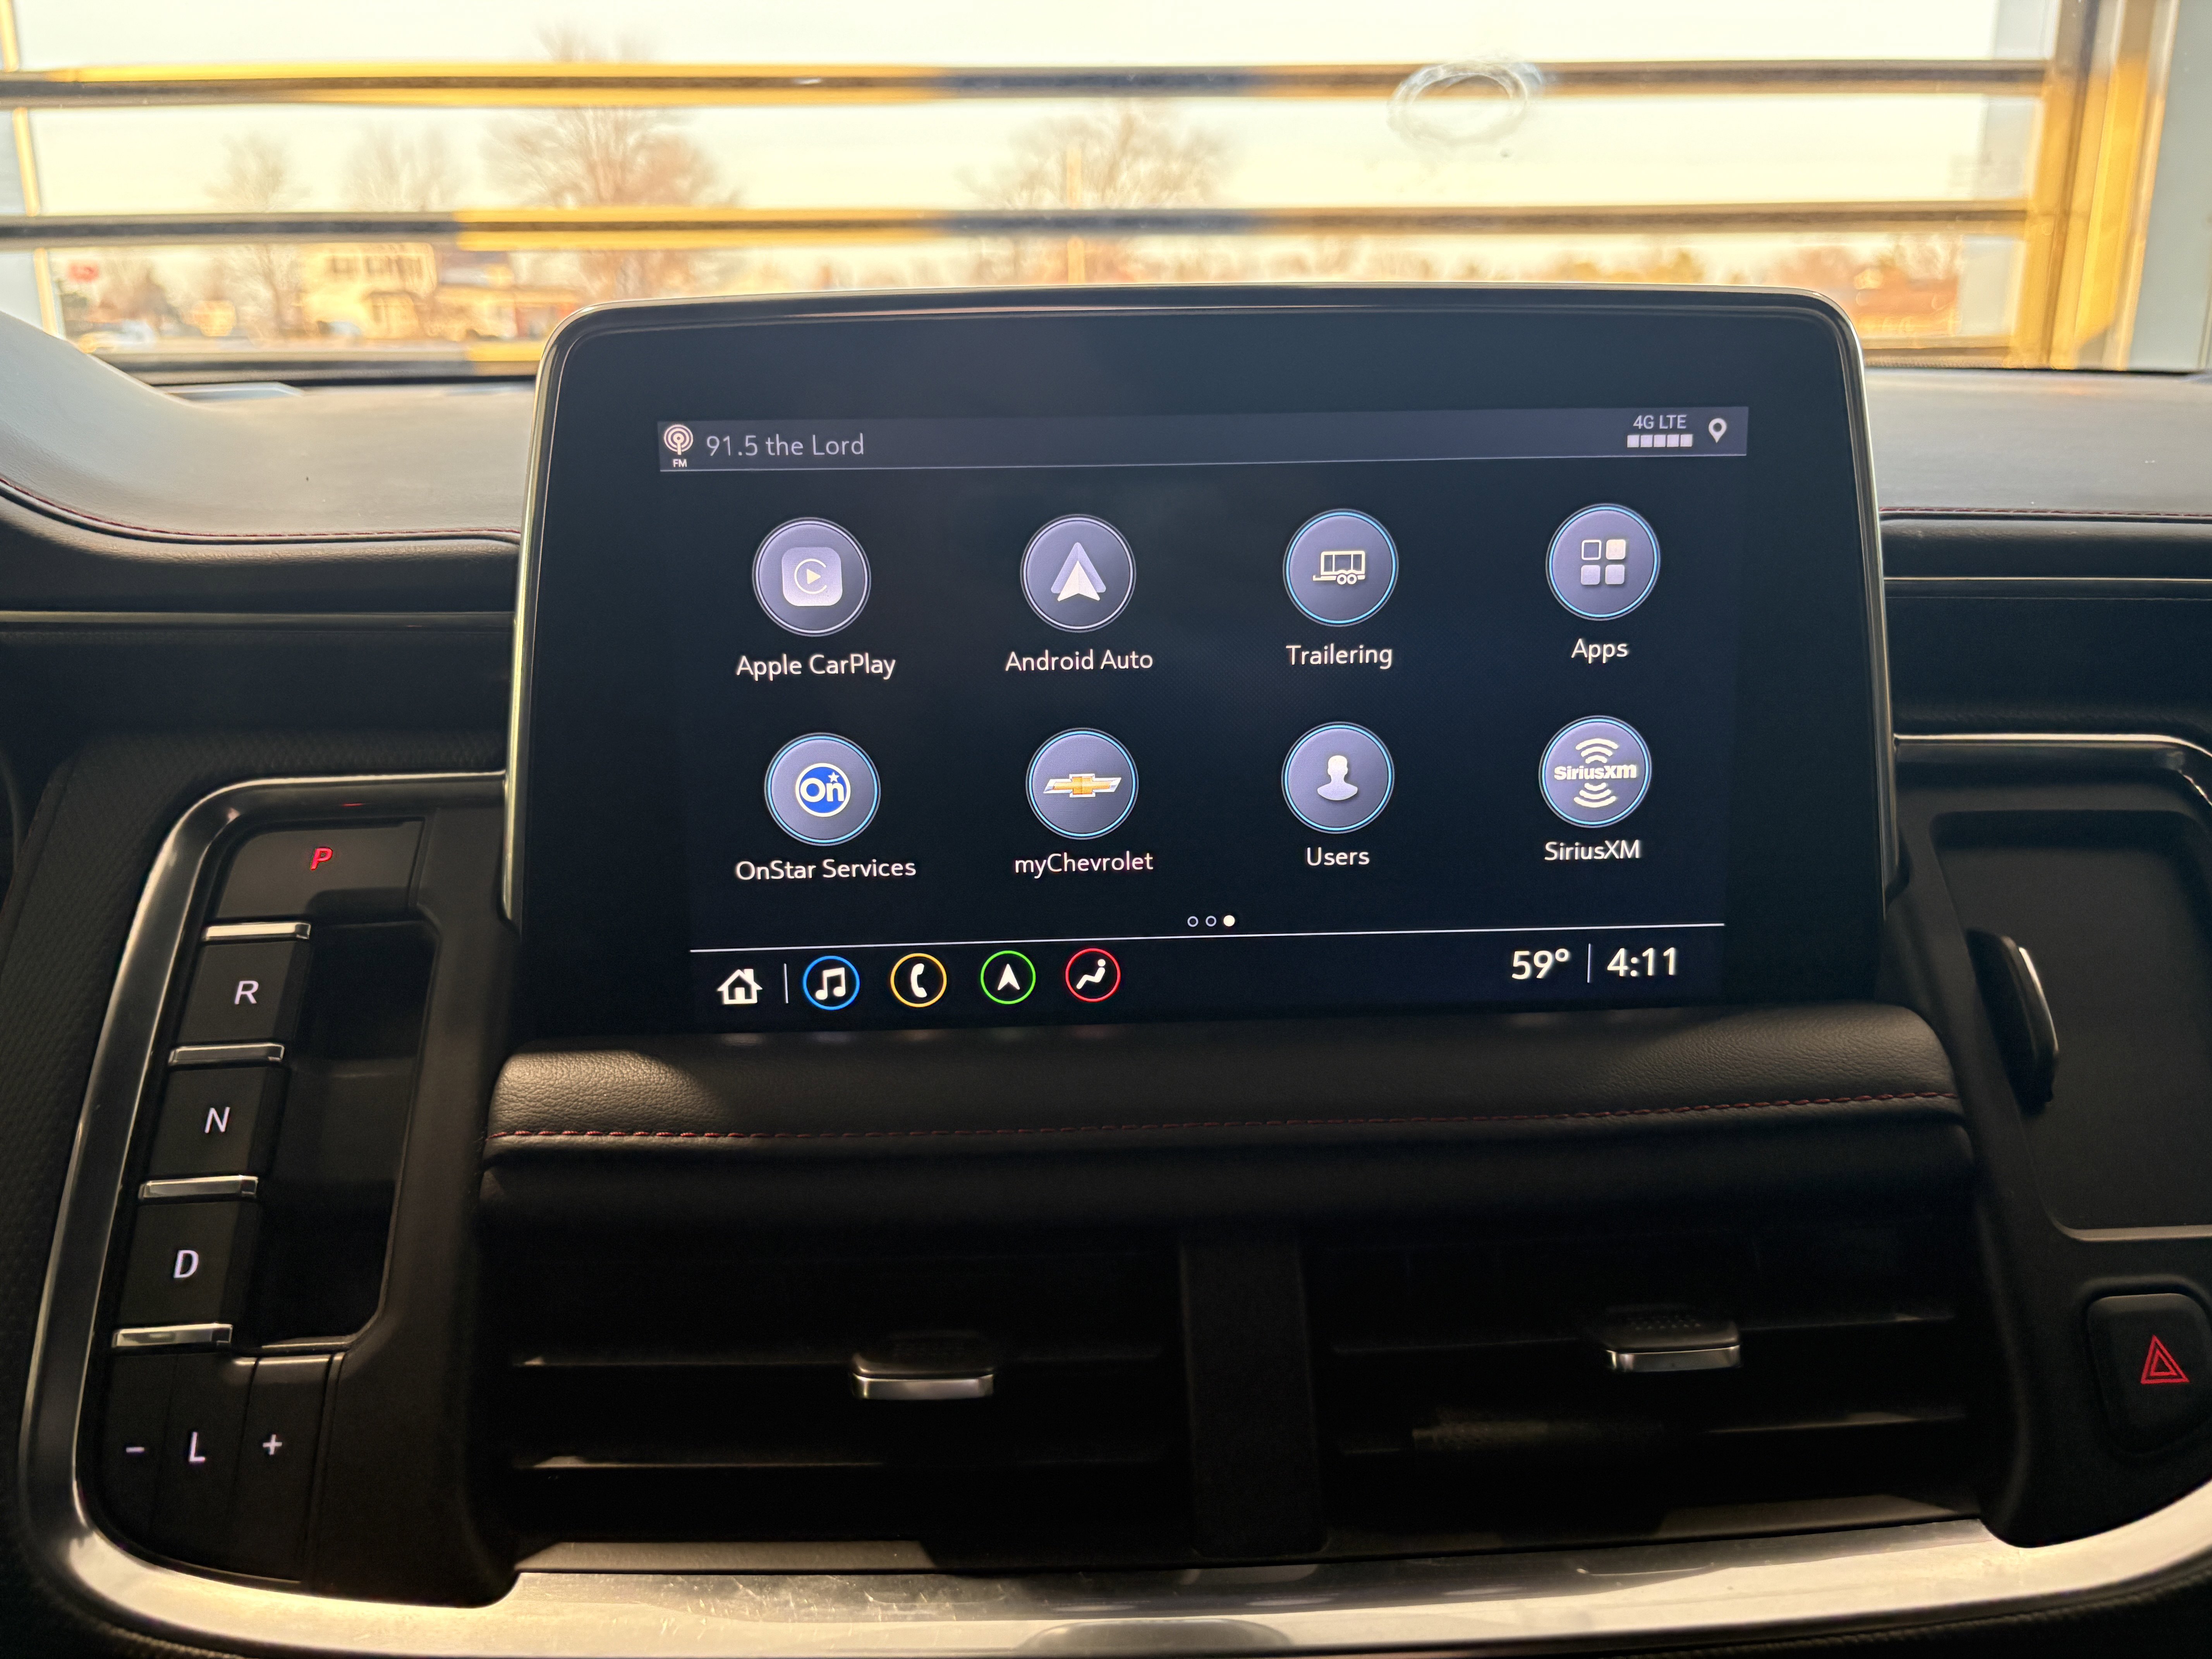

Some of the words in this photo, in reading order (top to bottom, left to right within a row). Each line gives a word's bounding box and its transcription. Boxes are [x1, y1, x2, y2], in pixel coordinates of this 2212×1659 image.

[1633, 415, 1654, 429] 4G
[1659, 414, 1687, 429] LTE
[706, 435, 758, 456] 91.5
[765, 434, 804, 455] the
[812, 433, 864, 455] Lord
[673, 459, 687, 467] FM
[1005, 649, 1094, 671] Android
[1100, 649, 1153, 670] Auto
[1286, 643, 1392, 670] Trailering
[1571, 638, 1628, 664] Apps
[736, 654, 802, 681] Apple
[809, 652, 896, 680] CarPlay
[800, 778, 844, 802] On
[310, 848, 333, 870] P
[1307, 847, 1370, 866] Users
[1544, 839, 1640, 860] SiriusXM
[736, 860, 816, 880] OnStar
[823, 859, 916, 878] Services
[1015, 850, 1153, 879] myChevrolet
[1607, 947, 1676, 977] 4:11
[234, 980, 259, 1005] R
[204, 1107, 230, 1133] N
[174, 1250, 199, 1278] D
[189, 1432, 206, 1463] L
